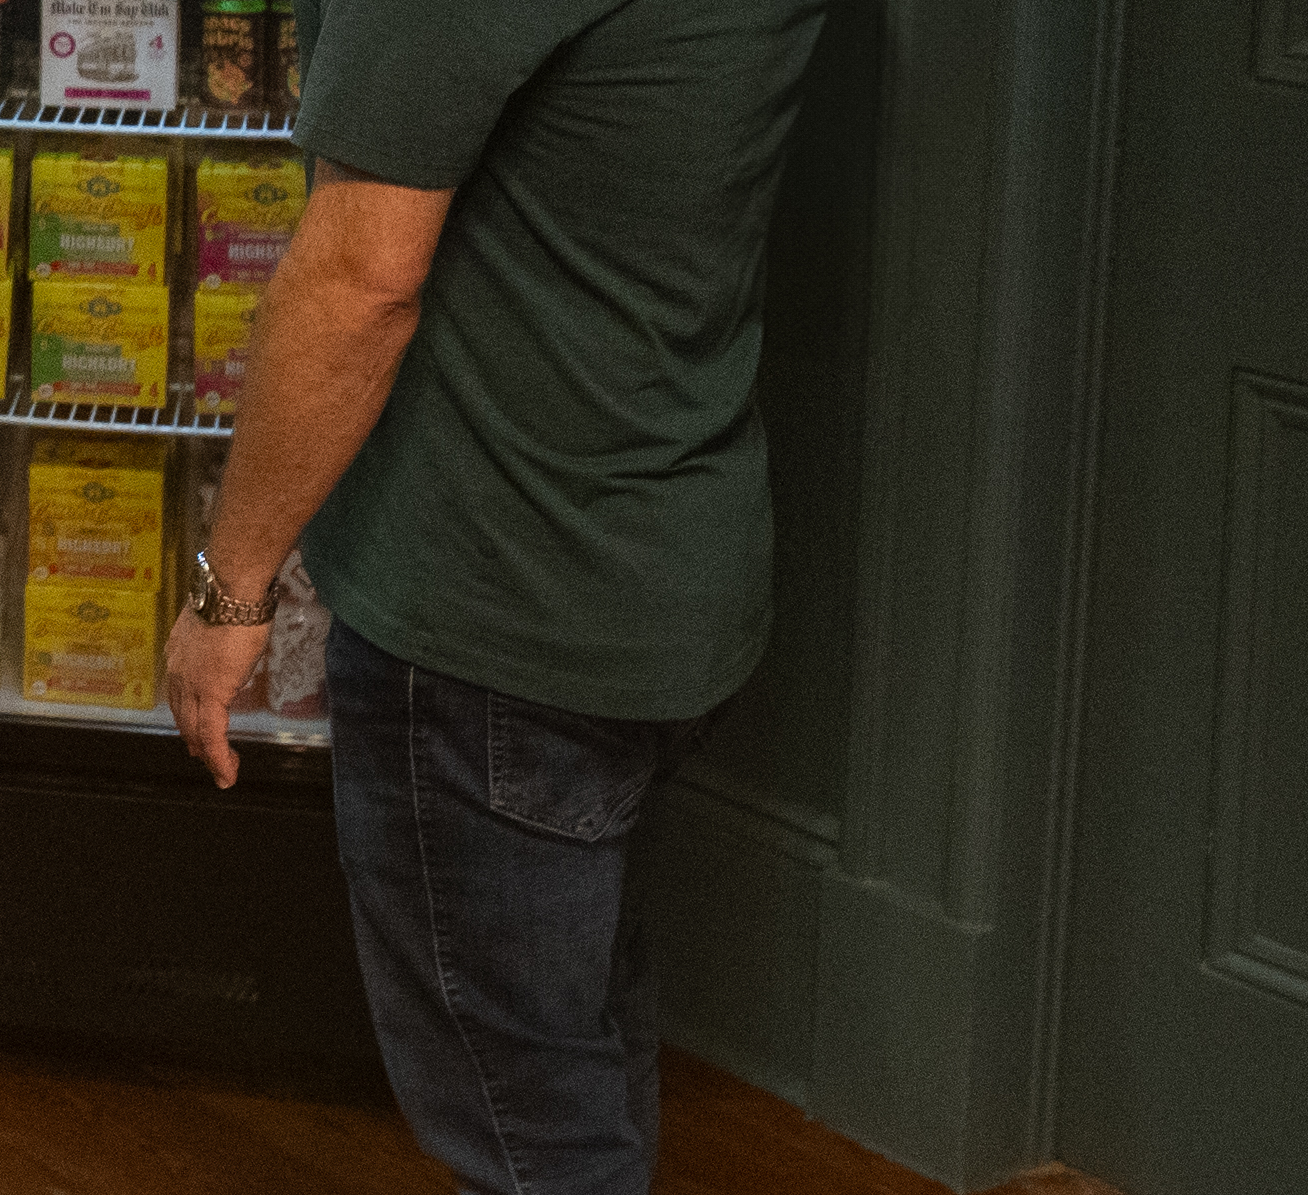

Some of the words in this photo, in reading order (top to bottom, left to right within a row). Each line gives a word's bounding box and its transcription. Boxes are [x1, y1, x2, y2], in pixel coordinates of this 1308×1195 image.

[50, 0, 86, 16] Make
[114, 2, 139, 20] Say
[149, 34, 164, 51] 4
[60, 233, 135, 252] HIGH&DRY
[62, 354, 136, 372] HIGH&DRY
